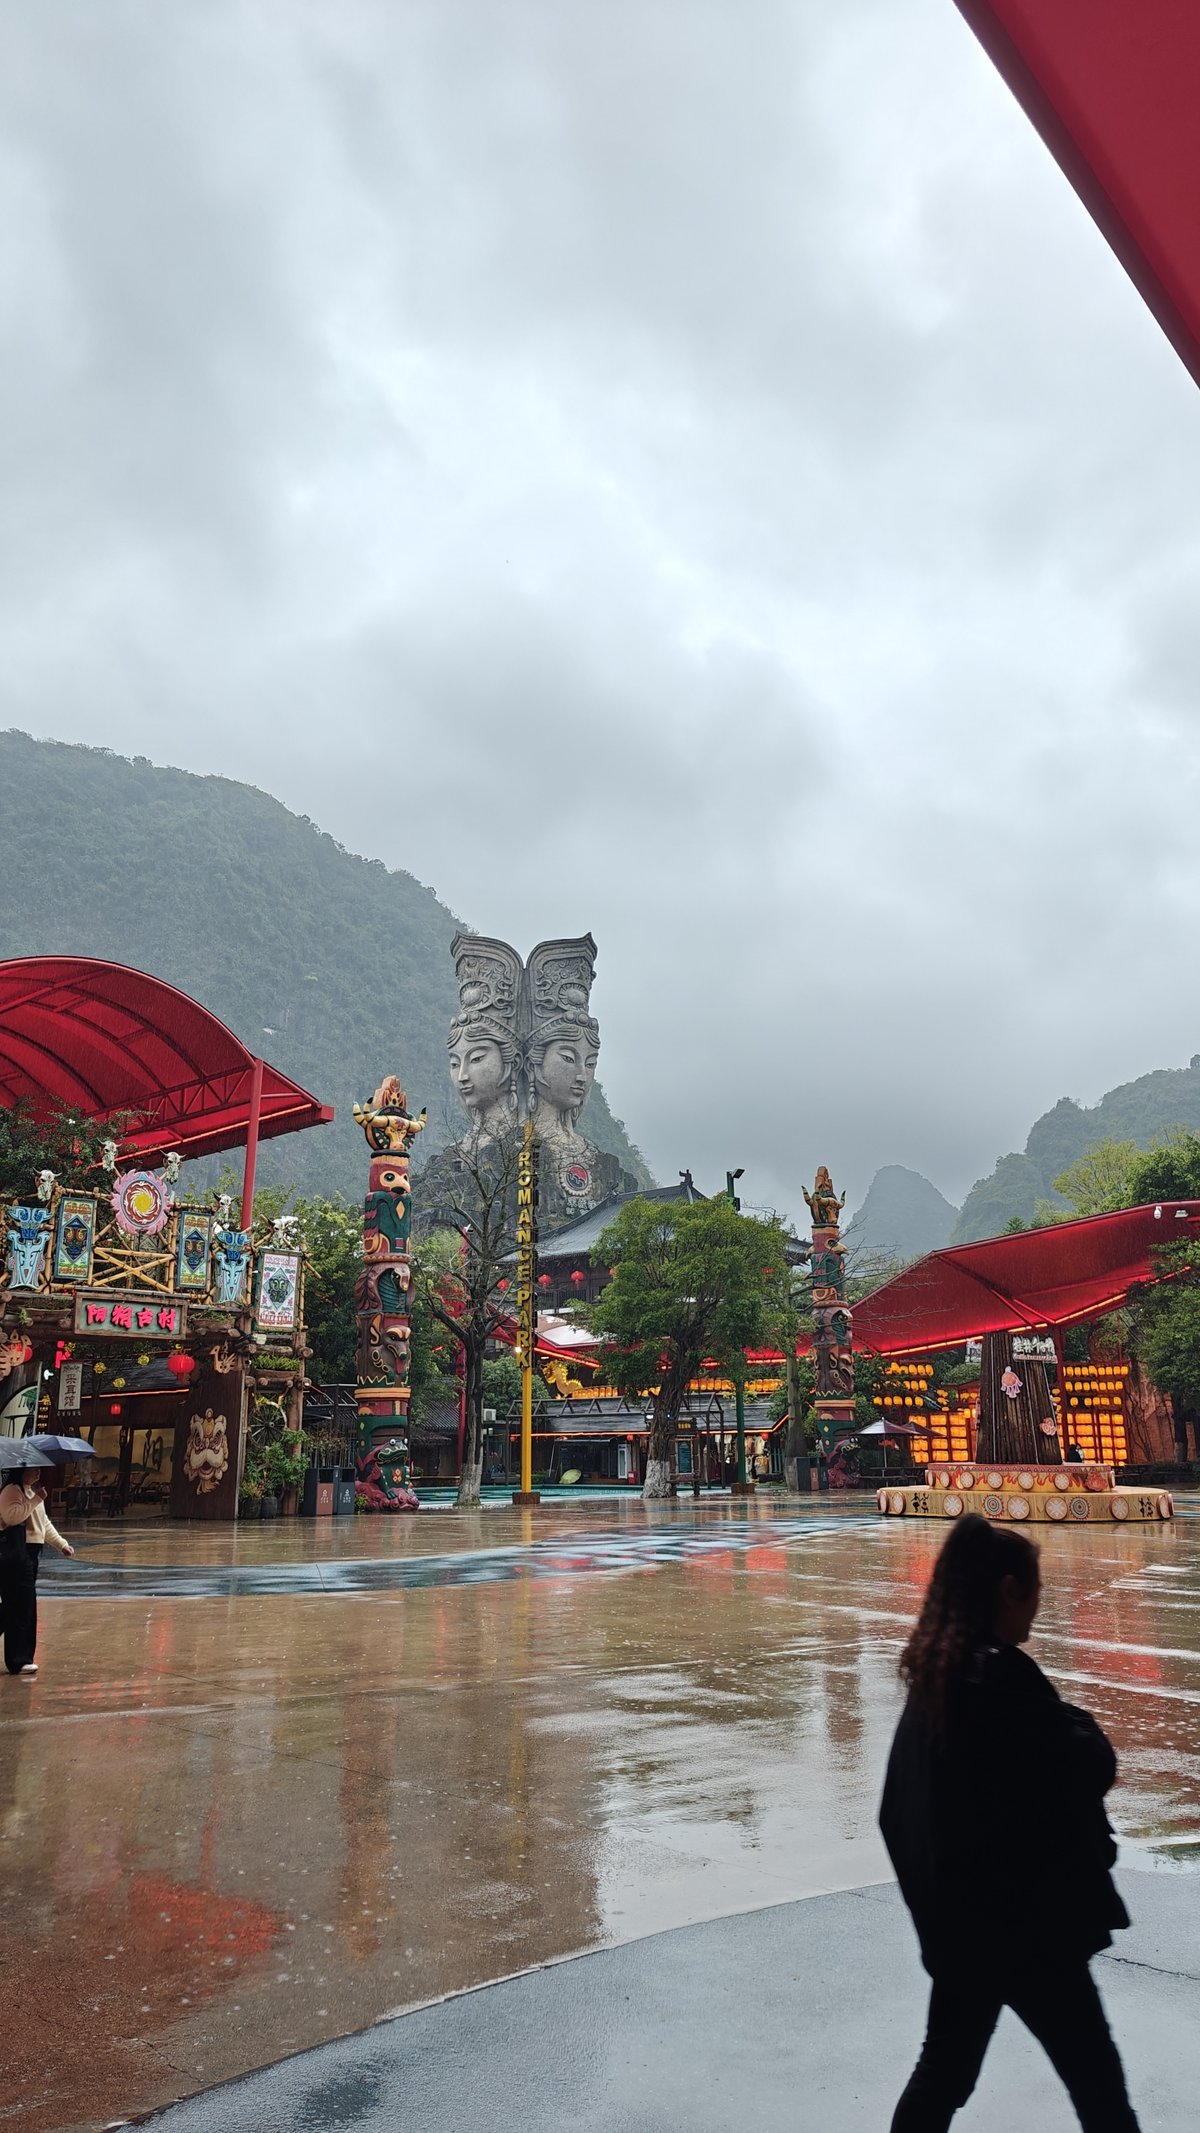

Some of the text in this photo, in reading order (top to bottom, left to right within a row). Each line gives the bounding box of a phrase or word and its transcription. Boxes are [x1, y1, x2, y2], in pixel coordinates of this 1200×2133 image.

[86, 1303, 176, 1332] 阳朔古村
[516, 1151, 532, 1367] ROMANCE PARK
